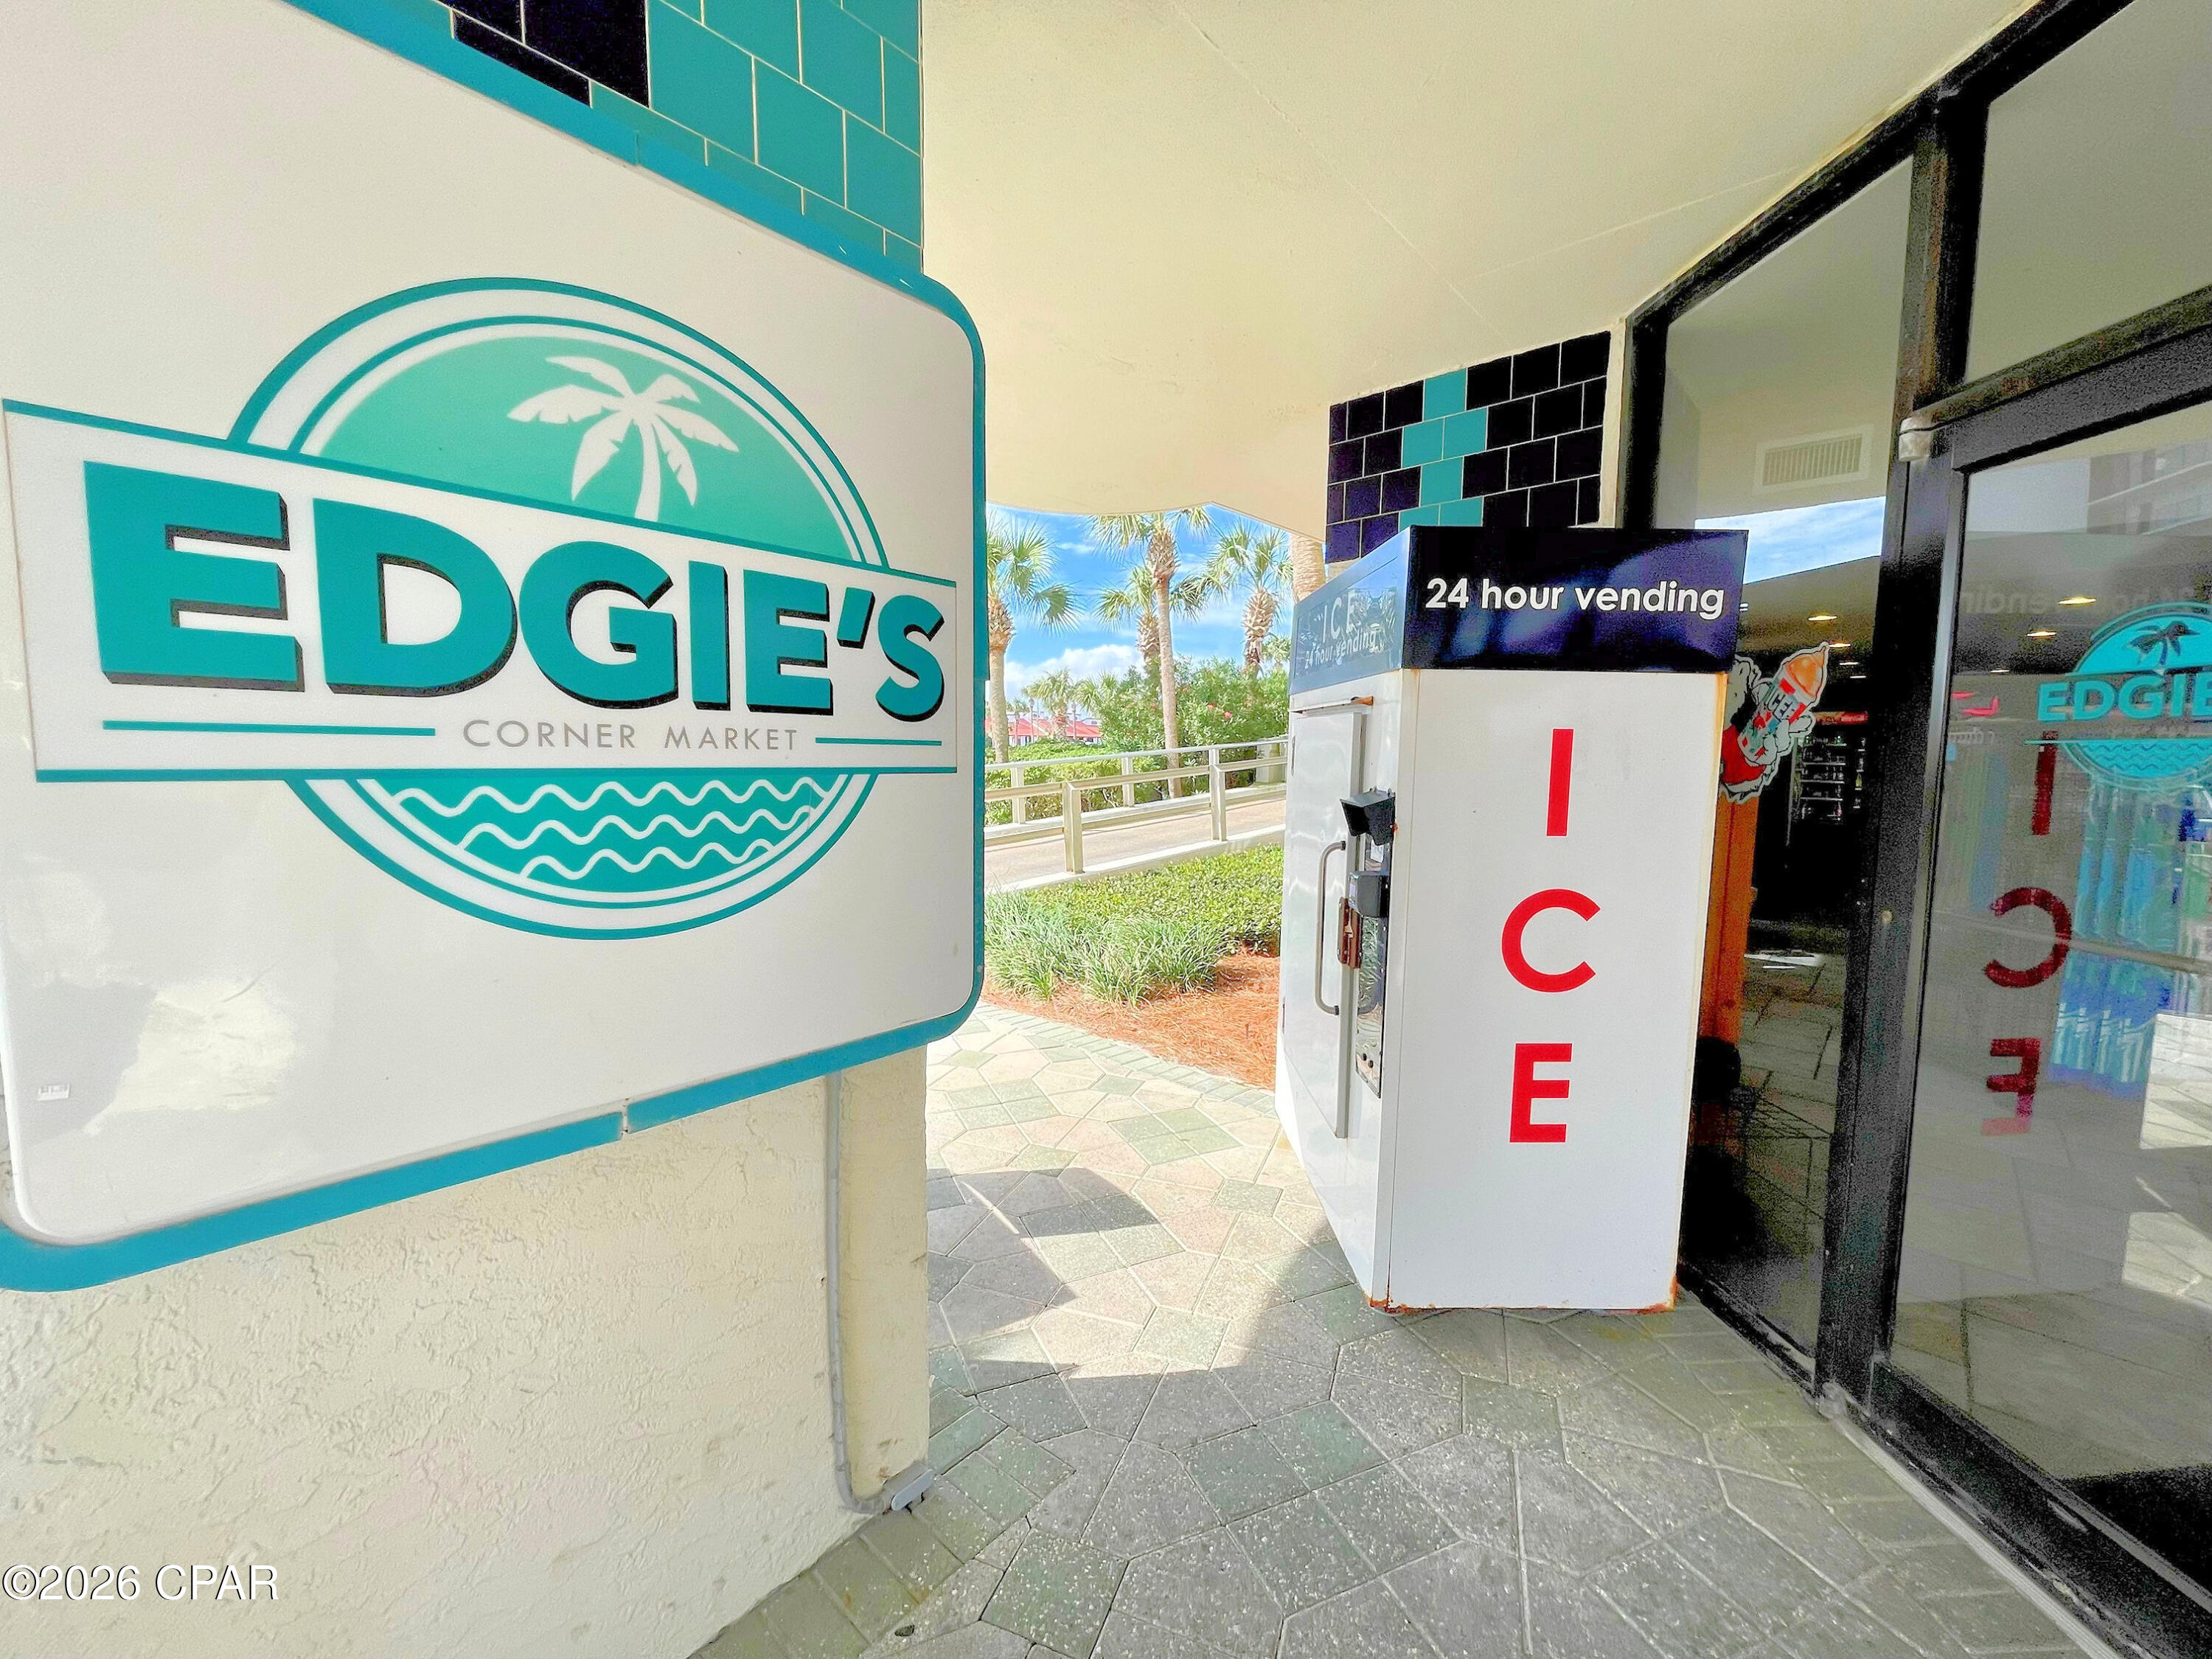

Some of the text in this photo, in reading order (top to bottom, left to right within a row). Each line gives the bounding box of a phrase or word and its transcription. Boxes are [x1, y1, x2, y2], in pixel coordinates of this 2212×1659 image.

[83, 461, 945, 722] EDGIE'S
[1425, 577, 1725, 620] 24 hour vending
[1315, 645, 1333, 666] hour
[1335, 629, 1377, 657] vending
[462, 719, 797, 751] CORNER MARKET
